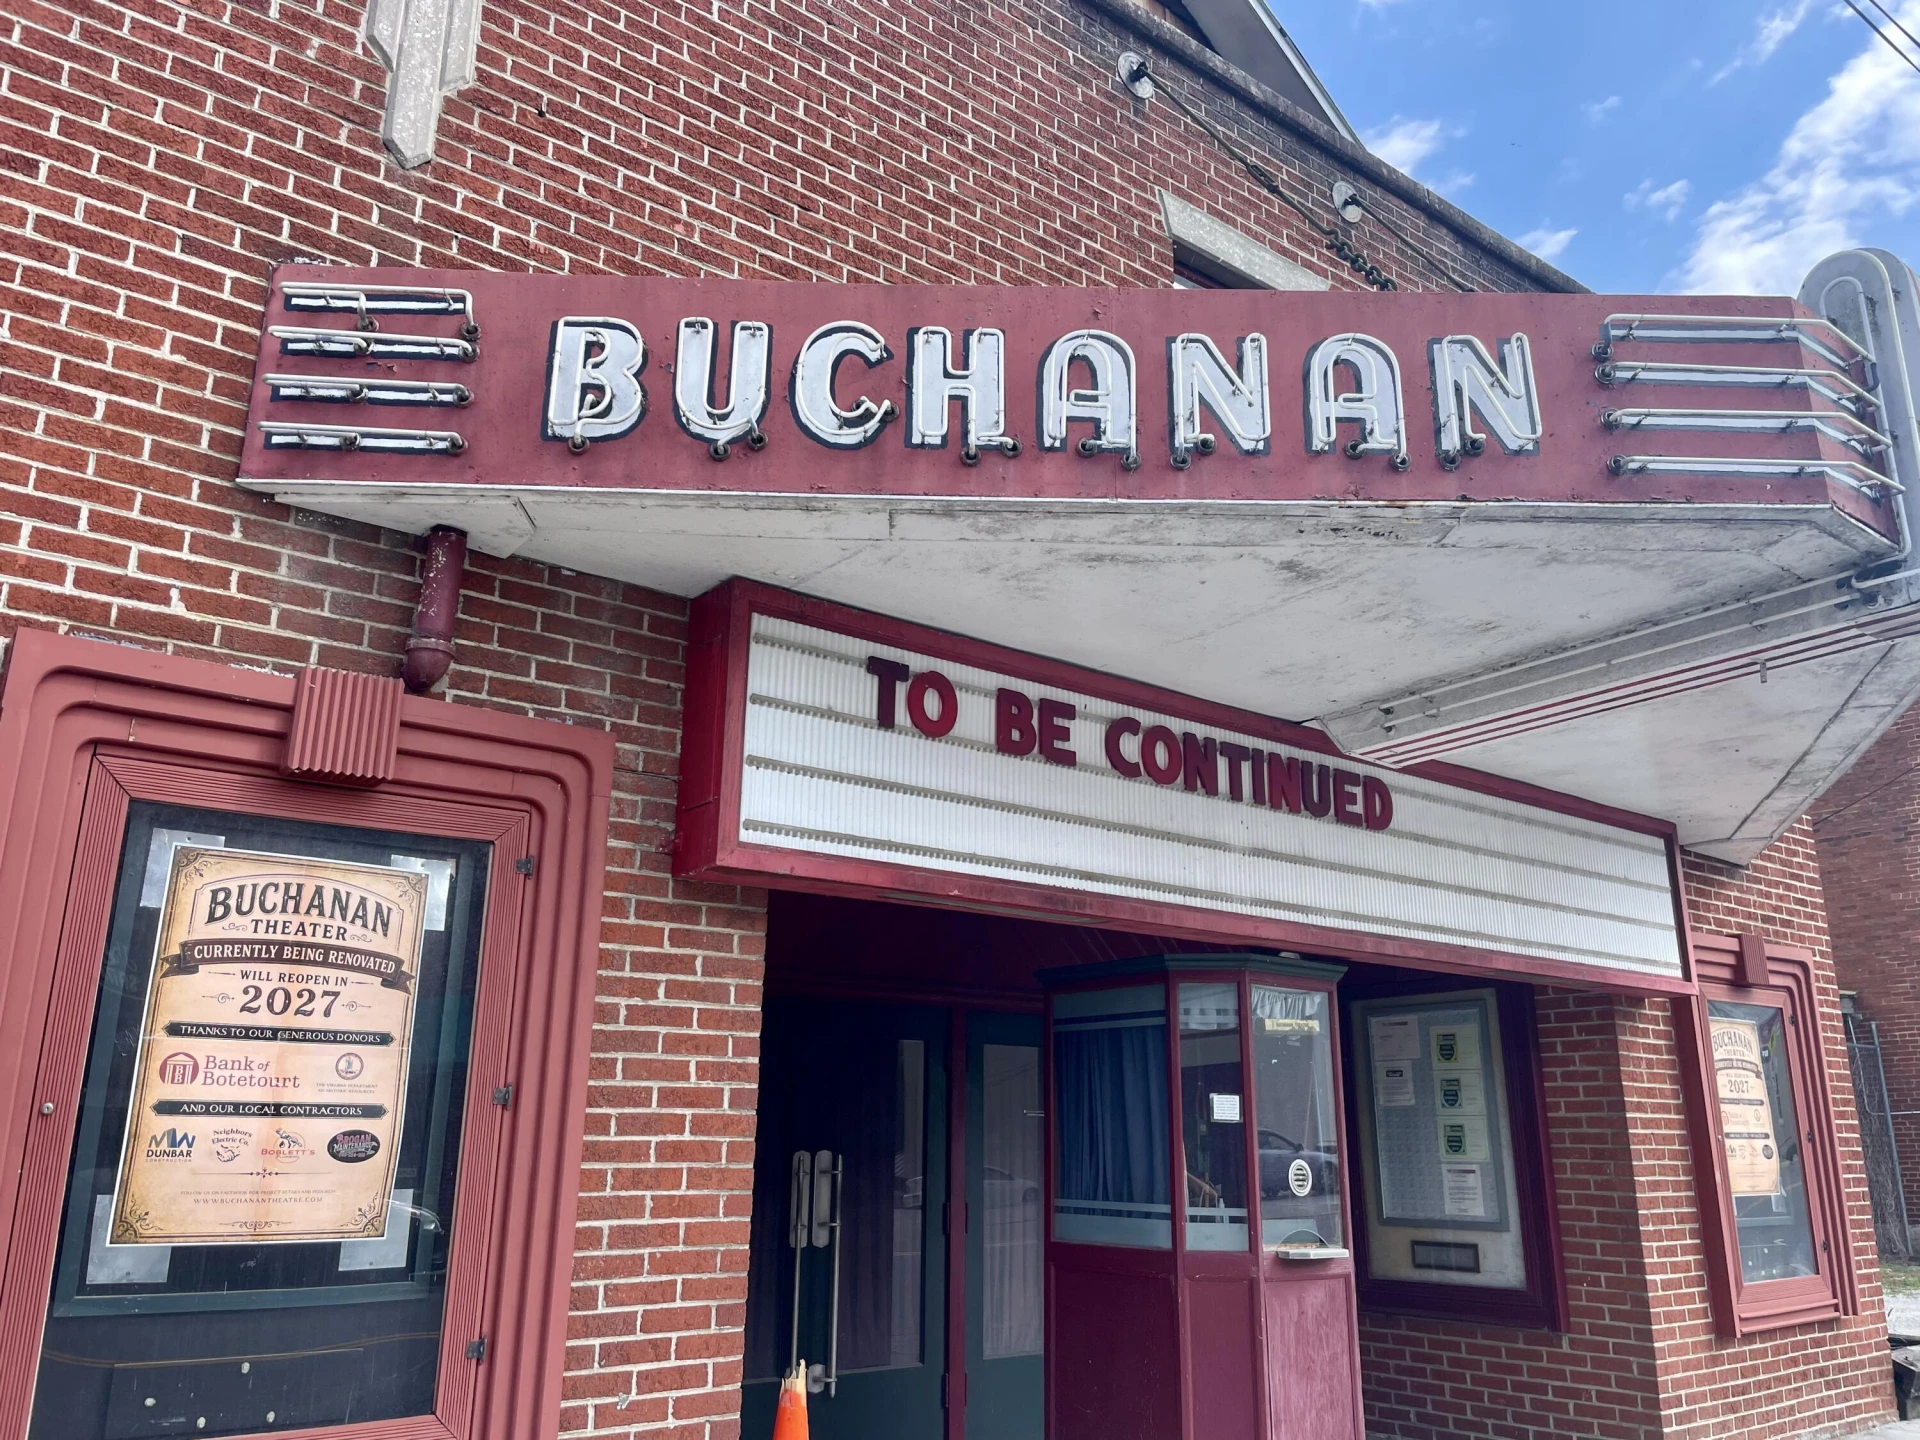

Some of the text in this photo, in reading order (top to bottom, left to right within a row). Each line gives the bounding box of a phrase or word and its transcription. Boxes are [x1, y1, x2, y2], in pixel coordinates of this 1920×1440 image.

[541, 316, 1542, 457] BUCHANAN
[868, 656, 1394, 832] TO BE CONTINUED
[204, 882, 393, 938] BUCHANAN
[251, 919, 347, 941] THEATER
[194, 944, 395, 973] CURRENTLY BEING RENOVATED
[240, 969, 348, 986] WILL REOPEN IN
[239, 984, 341, 1018] 2027
[180, 1024, 381, 1043] THANKS TO OUR GENEROUS DONORS
[1712, 1030, 1753, 1054] BUCHANAN
[204, 1055, 270, 1071] Bank of
[201, 1071, 300, 1088] Botetourt
[1727, 1080, 1749, 1093] 2027
[180, 1103, 362, 1115] AND OUR LOCAL CONTRACTORS
[212, 1136, 249, 1146] Electric Co.
[213, 1128, 253, 1138] Neighbors
[336, 1133, 372, 1145] BROGAN
[146, 1149, 192, 1158] DUNBAR
